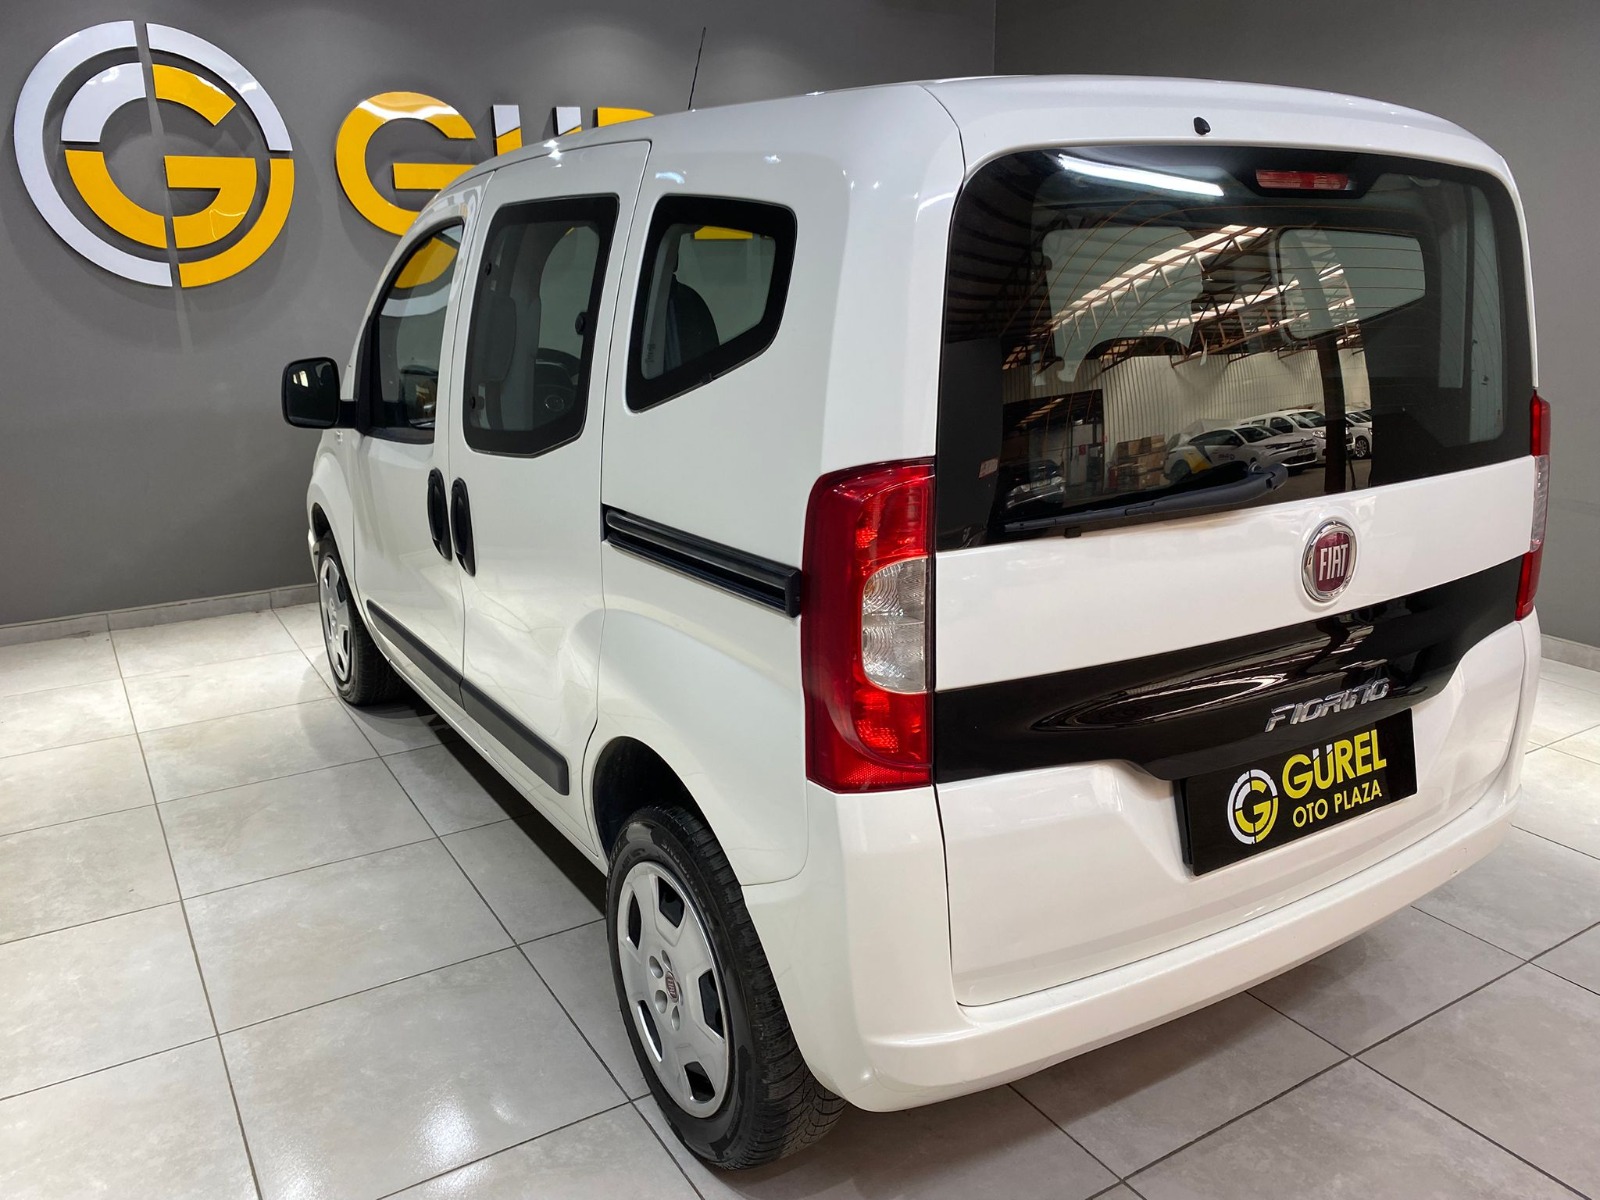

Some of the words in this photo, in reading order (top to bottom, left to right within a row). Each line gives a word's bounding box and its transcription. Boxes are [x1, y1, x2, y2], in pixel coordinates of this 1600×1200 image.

[1318, 543, 1349, 582] FIAT
[1282, 729, 1387, 799] GÜREL
[1292, 798, 1329, 828] OTO
[1334, 779, 1383, 814] PLAZA
